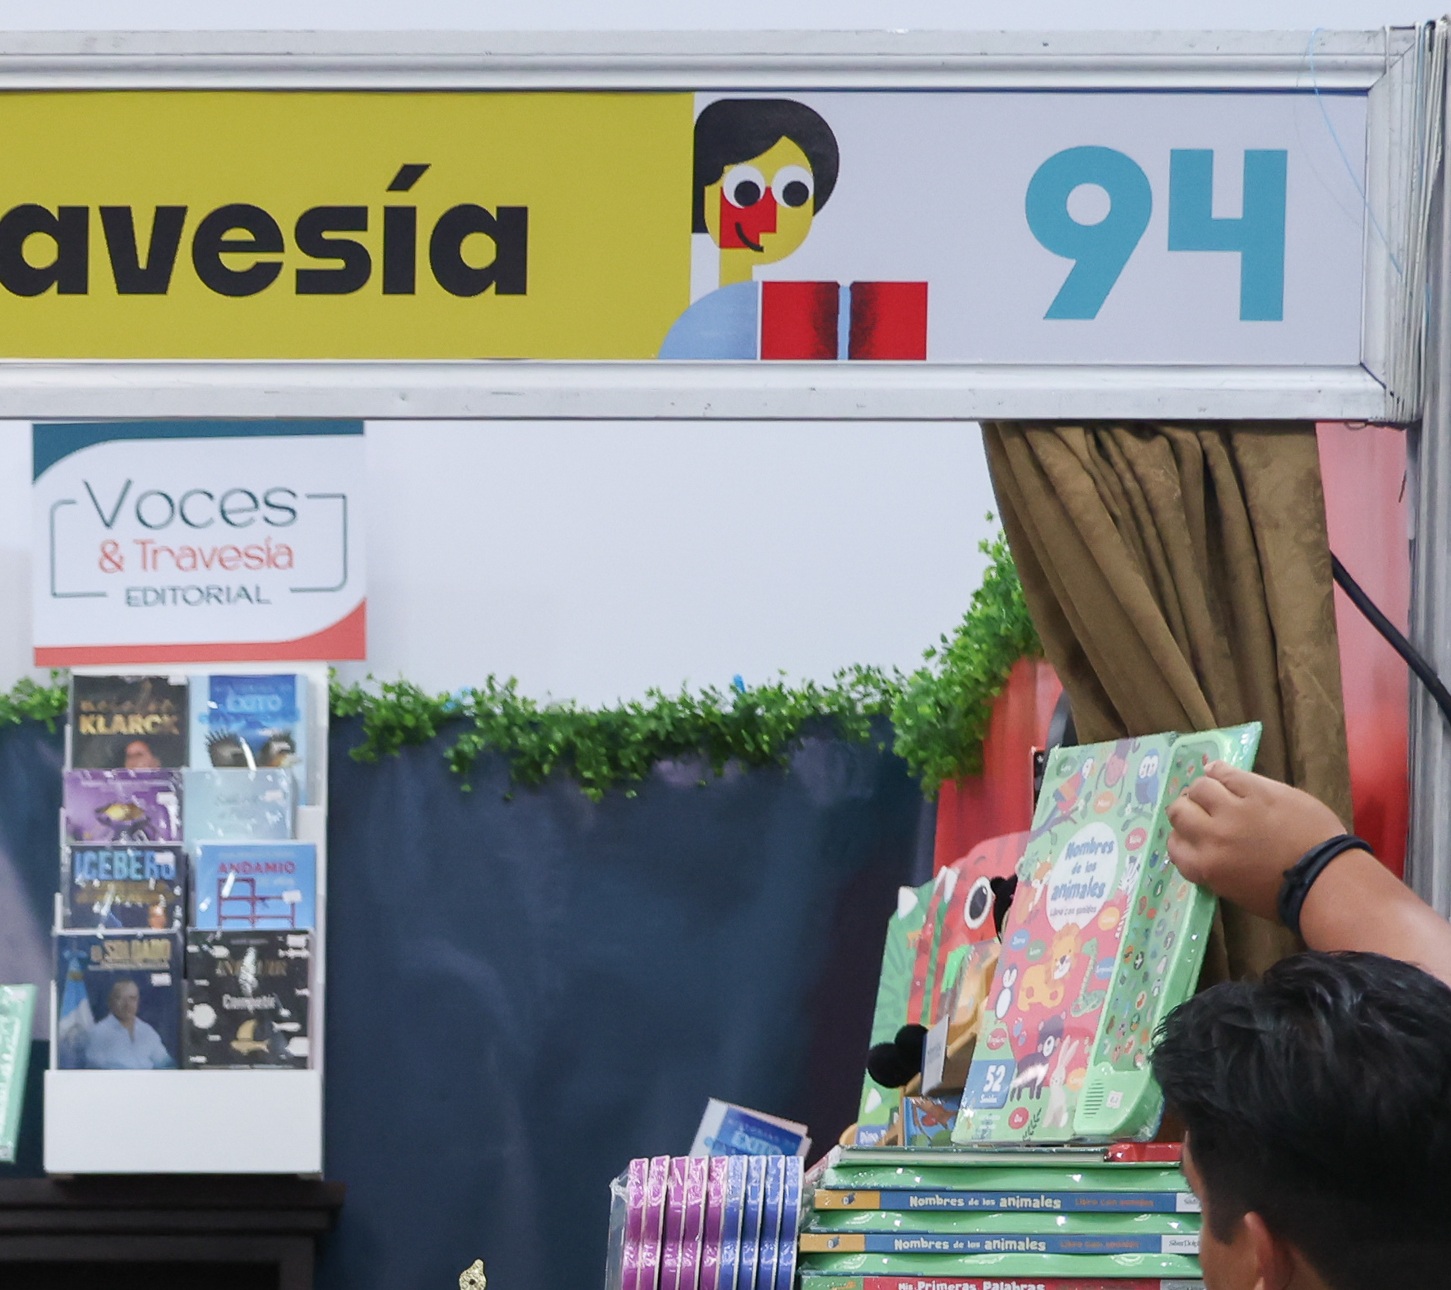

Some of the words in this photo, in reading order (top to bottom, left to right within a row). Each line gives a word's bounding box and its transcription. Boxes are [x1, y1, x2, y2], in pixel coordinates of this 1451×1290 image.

[1025, 144, 1288, 321] 94
[83, 479, 299, 530] Voces
[98, 539, 125, 573] &
[134, 536, 294, 572] Travesía
[126, 586, 272, 607] EDITORIAL
[1065, 837, 1114, 860] Nombres
[218, 861, 295, 874] ANDAMIO
[1051, 876, 1106, 901] animales
[983, 1065, 1006, 1092] 52
[909, 1195, 965, 1208] Nombres
[968, 1198, 980, 1206] de
[982, 1197, 996, 1206] los
[999, 1195, 1061, 1209] animales
[895, 1239, 950, 1251] Nombres
[953, 1241, 964, 1249] de
[967, 1240, 981, 1249] los
[984, 1237, 1046, 1252] animales
